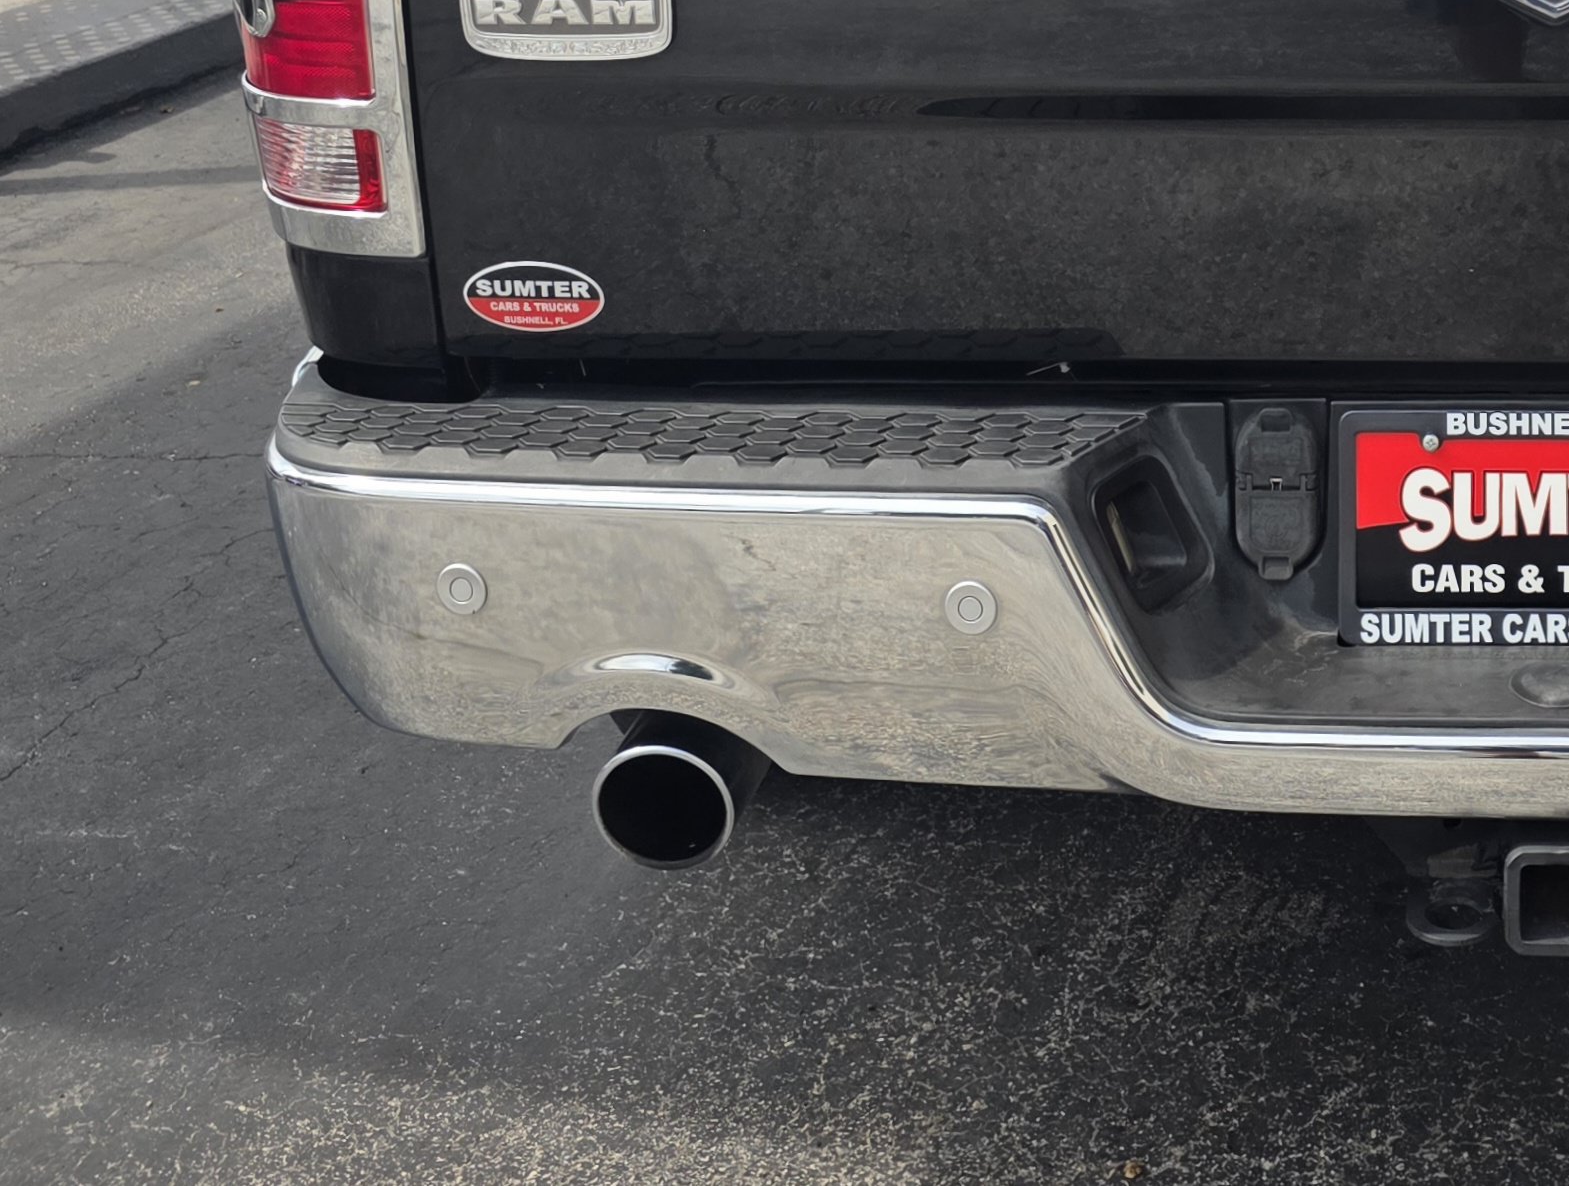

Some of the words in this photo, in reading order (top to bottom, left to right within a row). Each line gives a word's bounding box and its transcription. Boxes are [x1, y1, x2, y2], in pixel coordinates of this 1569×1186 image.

[475, 279, 591, 298] SUMTER
[490, 301, 521, 312] CARS
[522, 302, 532, 312] &
[534, 302, 580, 313] TRUCKS
[504, 315, 554, 325] BUSHNELL,
[1411, 563, 1506, 594] CARS
[1517, 564, 1545, 594] &
[1360, 613, 1493, 644] SUMTER
